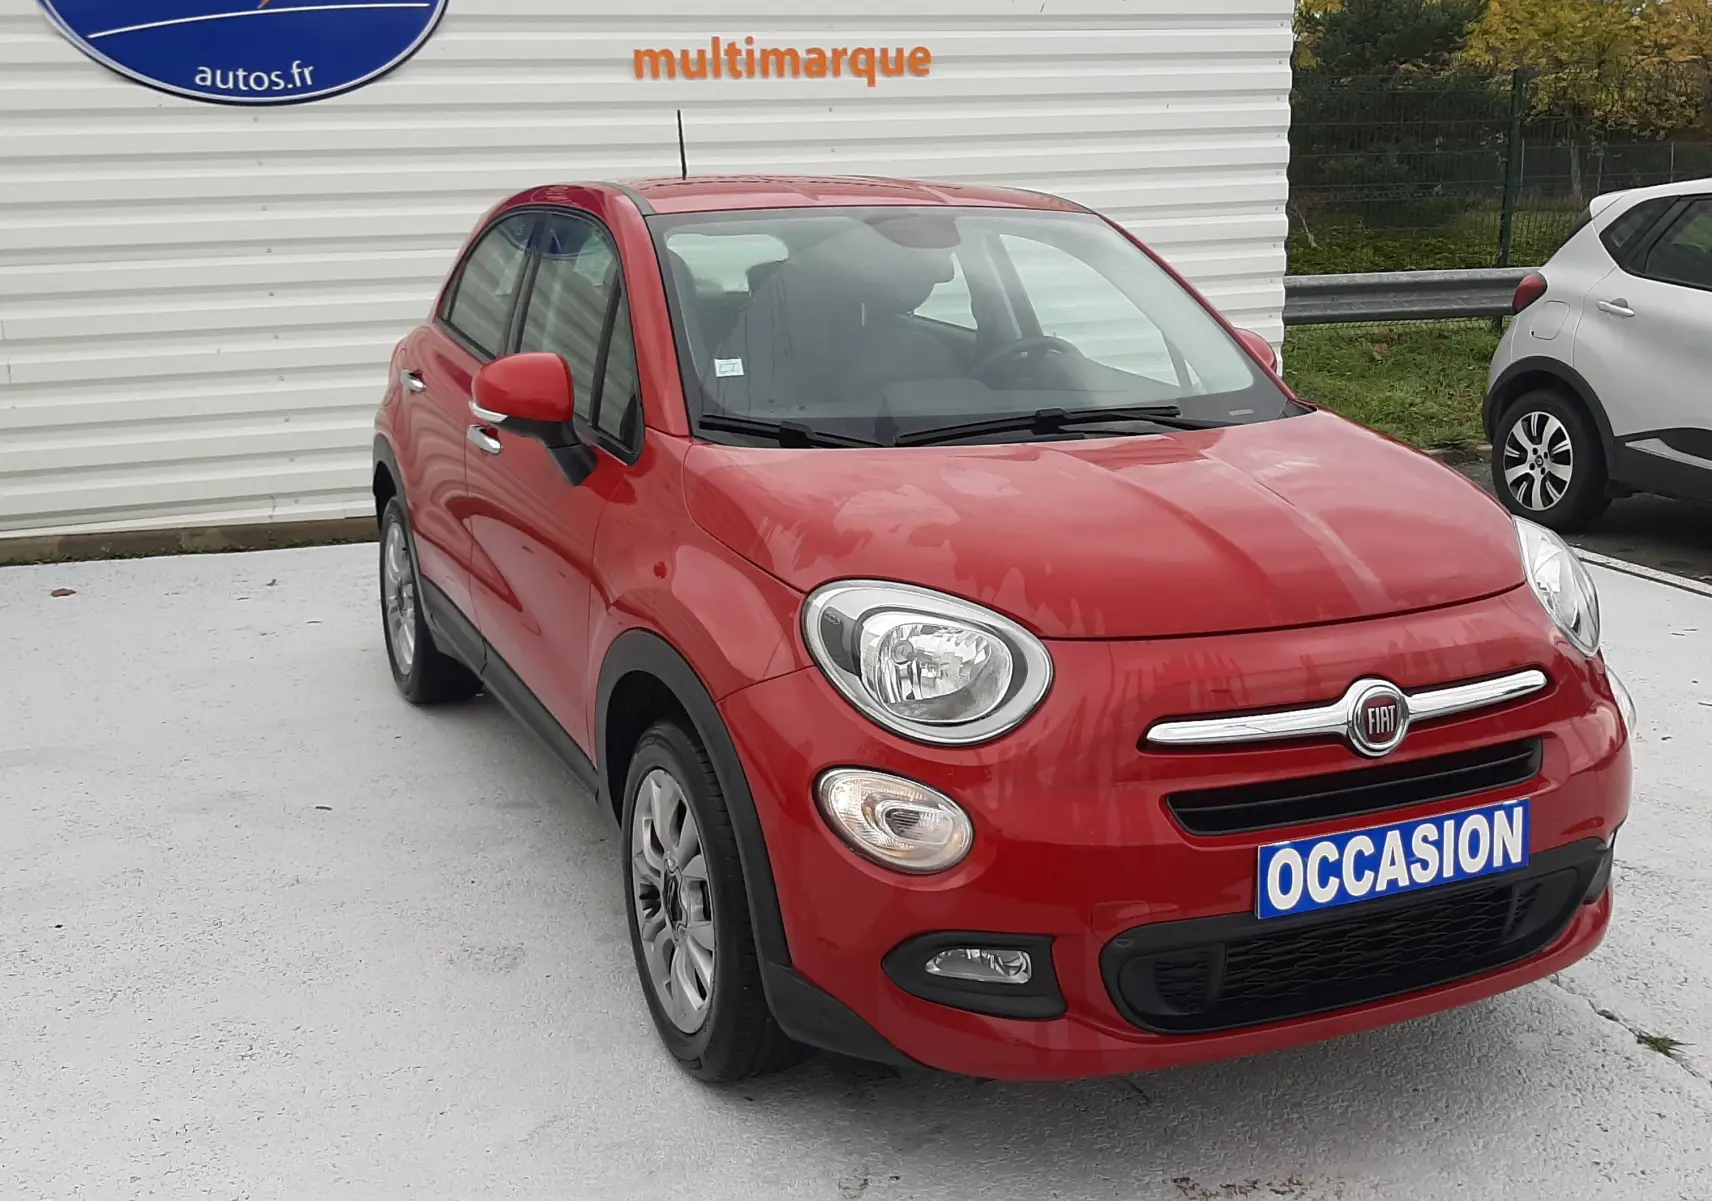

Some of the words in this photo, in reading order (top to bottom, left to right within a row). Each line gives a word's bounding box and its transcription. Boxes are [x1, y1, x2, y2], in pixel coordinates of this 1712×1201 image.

[194, 60, 314, 91] autos.fr
[633, 36, 932, 87] multimarque
[1367, 704, 1396, 735] FIAT
[1267, 806, 1524, 911] OCCASION
